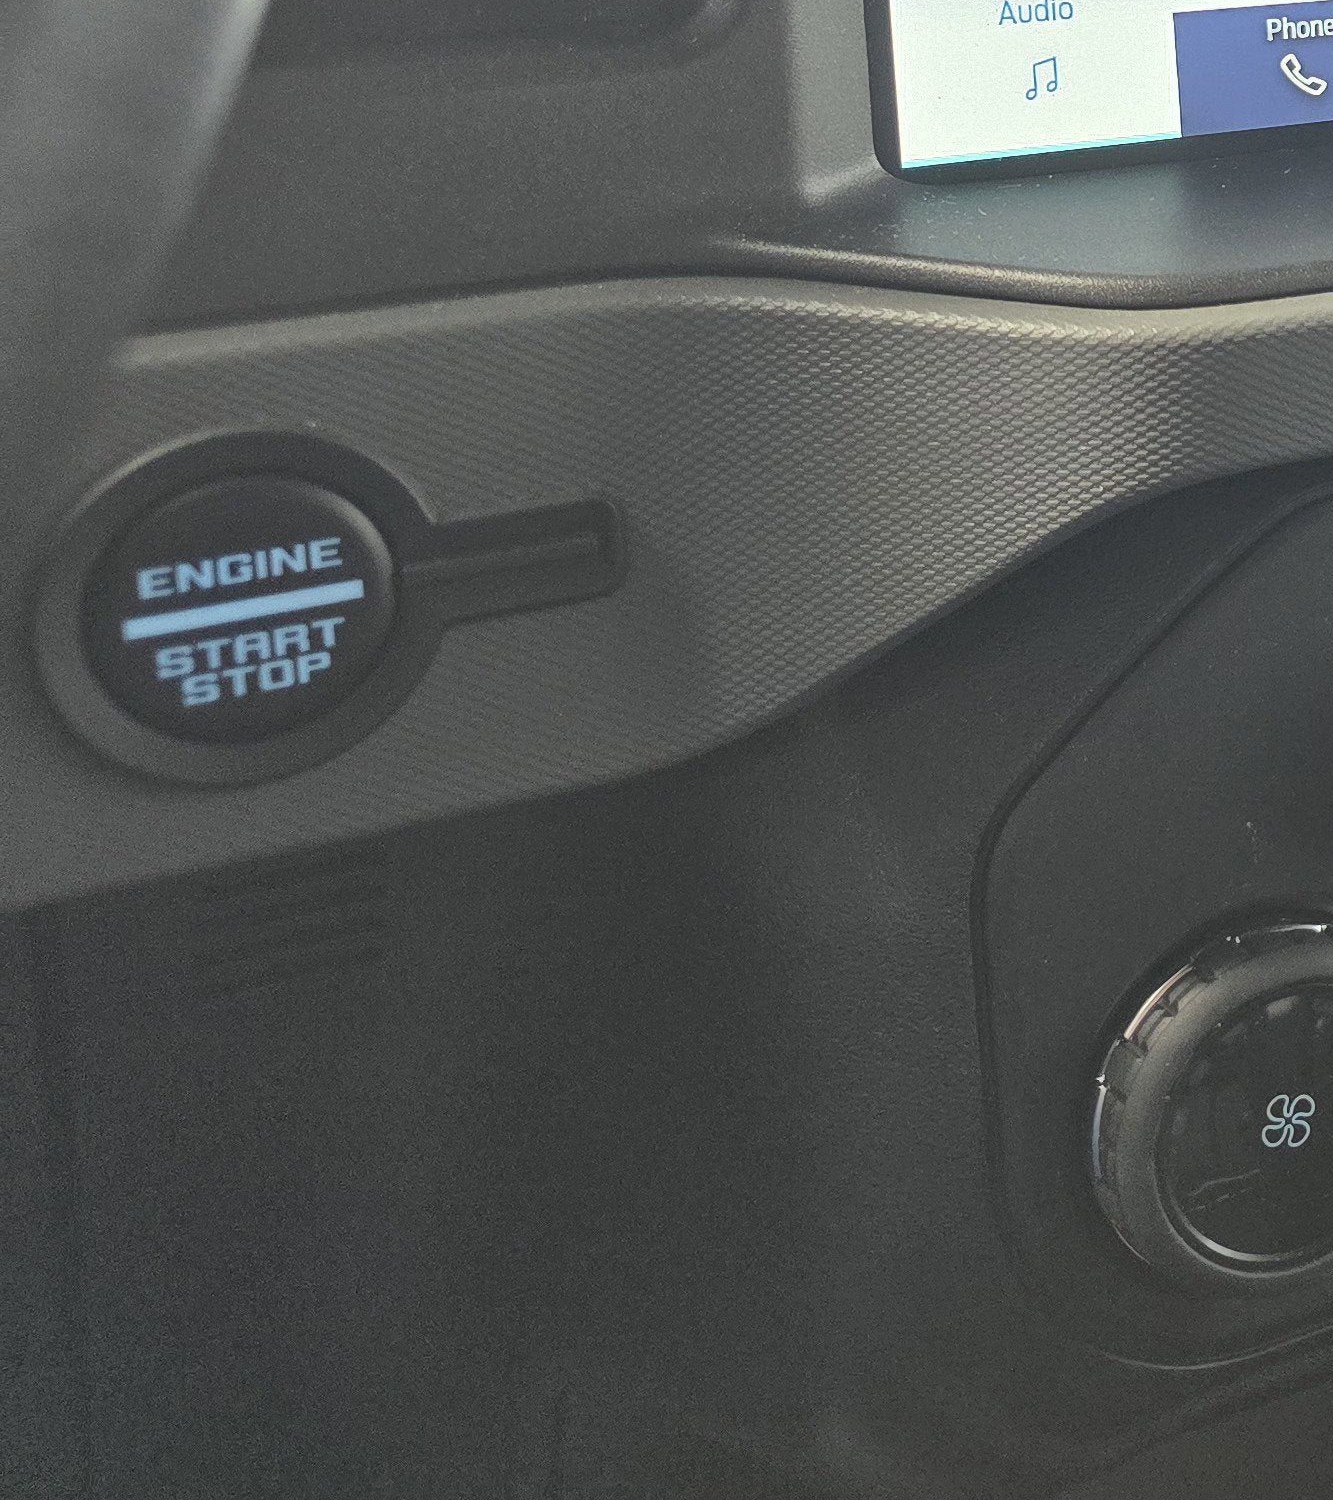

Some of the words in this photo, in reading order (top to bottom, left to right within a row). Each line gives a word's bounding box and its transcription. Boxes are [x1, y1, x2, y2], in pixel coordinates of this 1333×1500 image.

[136, 537, 344, 600] ENGINE
[155, 617, 346, 680] START
[182, 651, 332, 708] STOP
